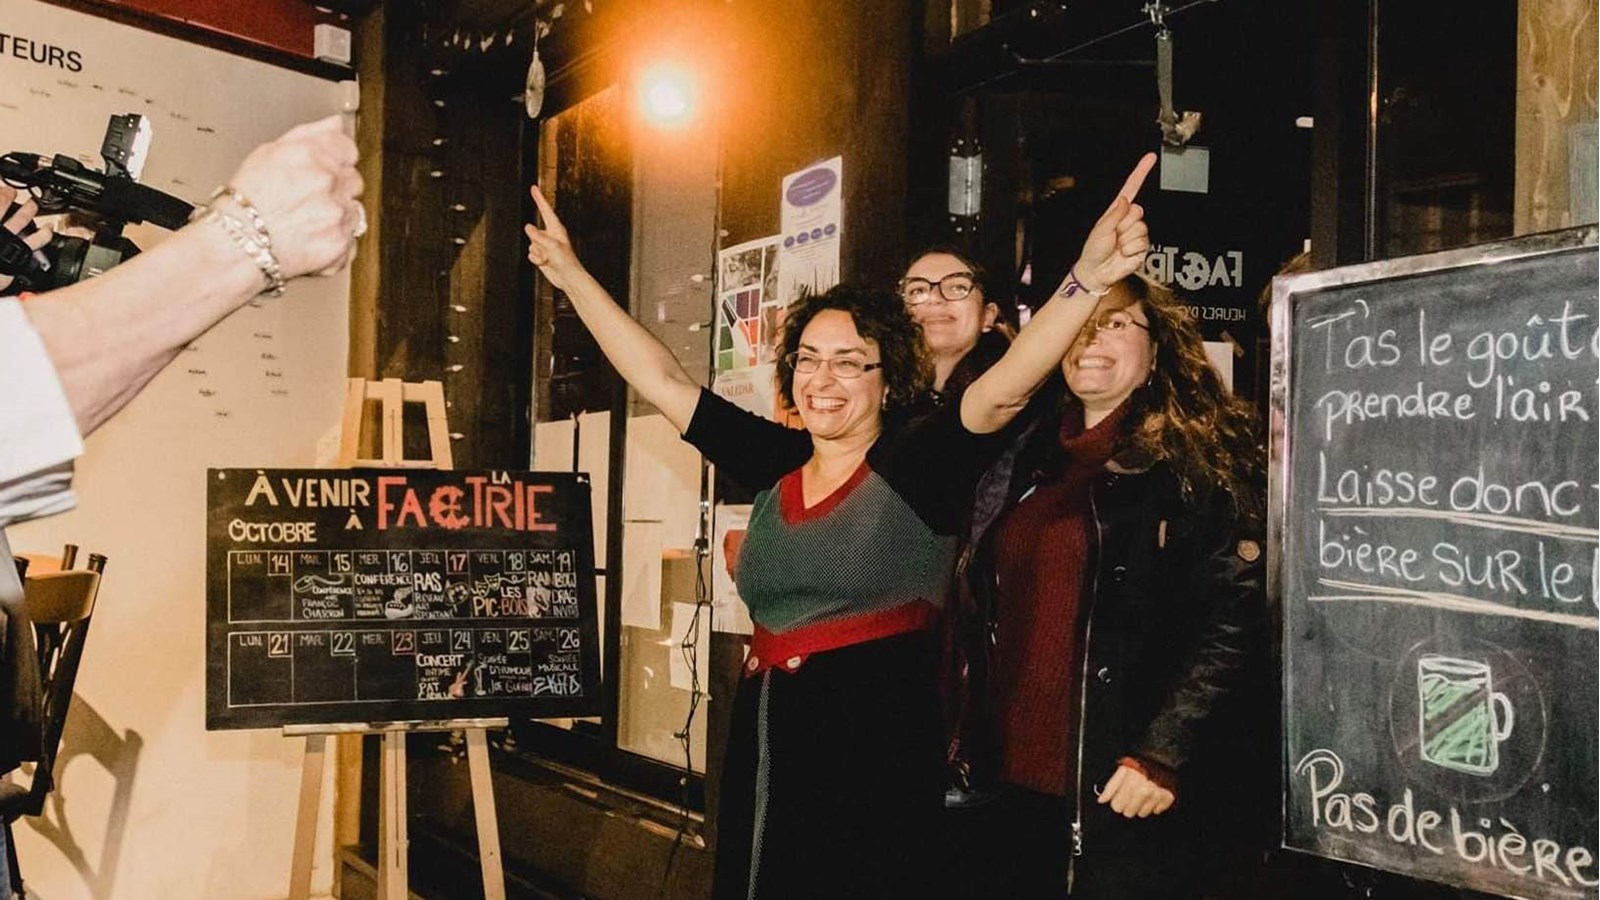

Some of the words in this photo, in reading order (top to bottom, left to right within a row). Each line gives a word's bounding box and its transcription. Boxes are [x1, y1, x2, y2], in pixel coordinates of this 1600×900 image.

[1420, 308, 1452, 366] le
[1467, 300, 1590, 388] goût
[491, 470, 512, 484] LA
[1317, 451, 1439, 506] Laisse
[1450, 465, 1581, 516] donc
[282, 478, 370, 507] VENIR
[377, 476, 557, 531] FACTRIE
[345, 509, 363, 530] À
[228, 518, 317, 543] OCTOBRE
[271, 554, 289, 573] 14
[334, 553, 351, 572] 15
[391, 552, 409, 572] 16
[450, 553, 466, 572] 17
[508, 552, 523, 571] 18
[556, 552, 571, 572] 19
[413, 572, 442, 592] RAS
[1539, 540, 1583, 604] le
[500, 586, 522, 599] LES
[552, 589, 577, 605] DRAG
[271, 634, 289, 654] 21
[334, 632, 353, 653] 22
[395, 632, 414, 651] 23
[454, 631, 471, 650] 24
[509, 630, 530, 651] 25
[560, 629, 580, 649] 26
[416, 653, 464, 668] CONCERT
[1295, 749, 1379, 833] Pas
[1387, 788, 1446, 855] de
